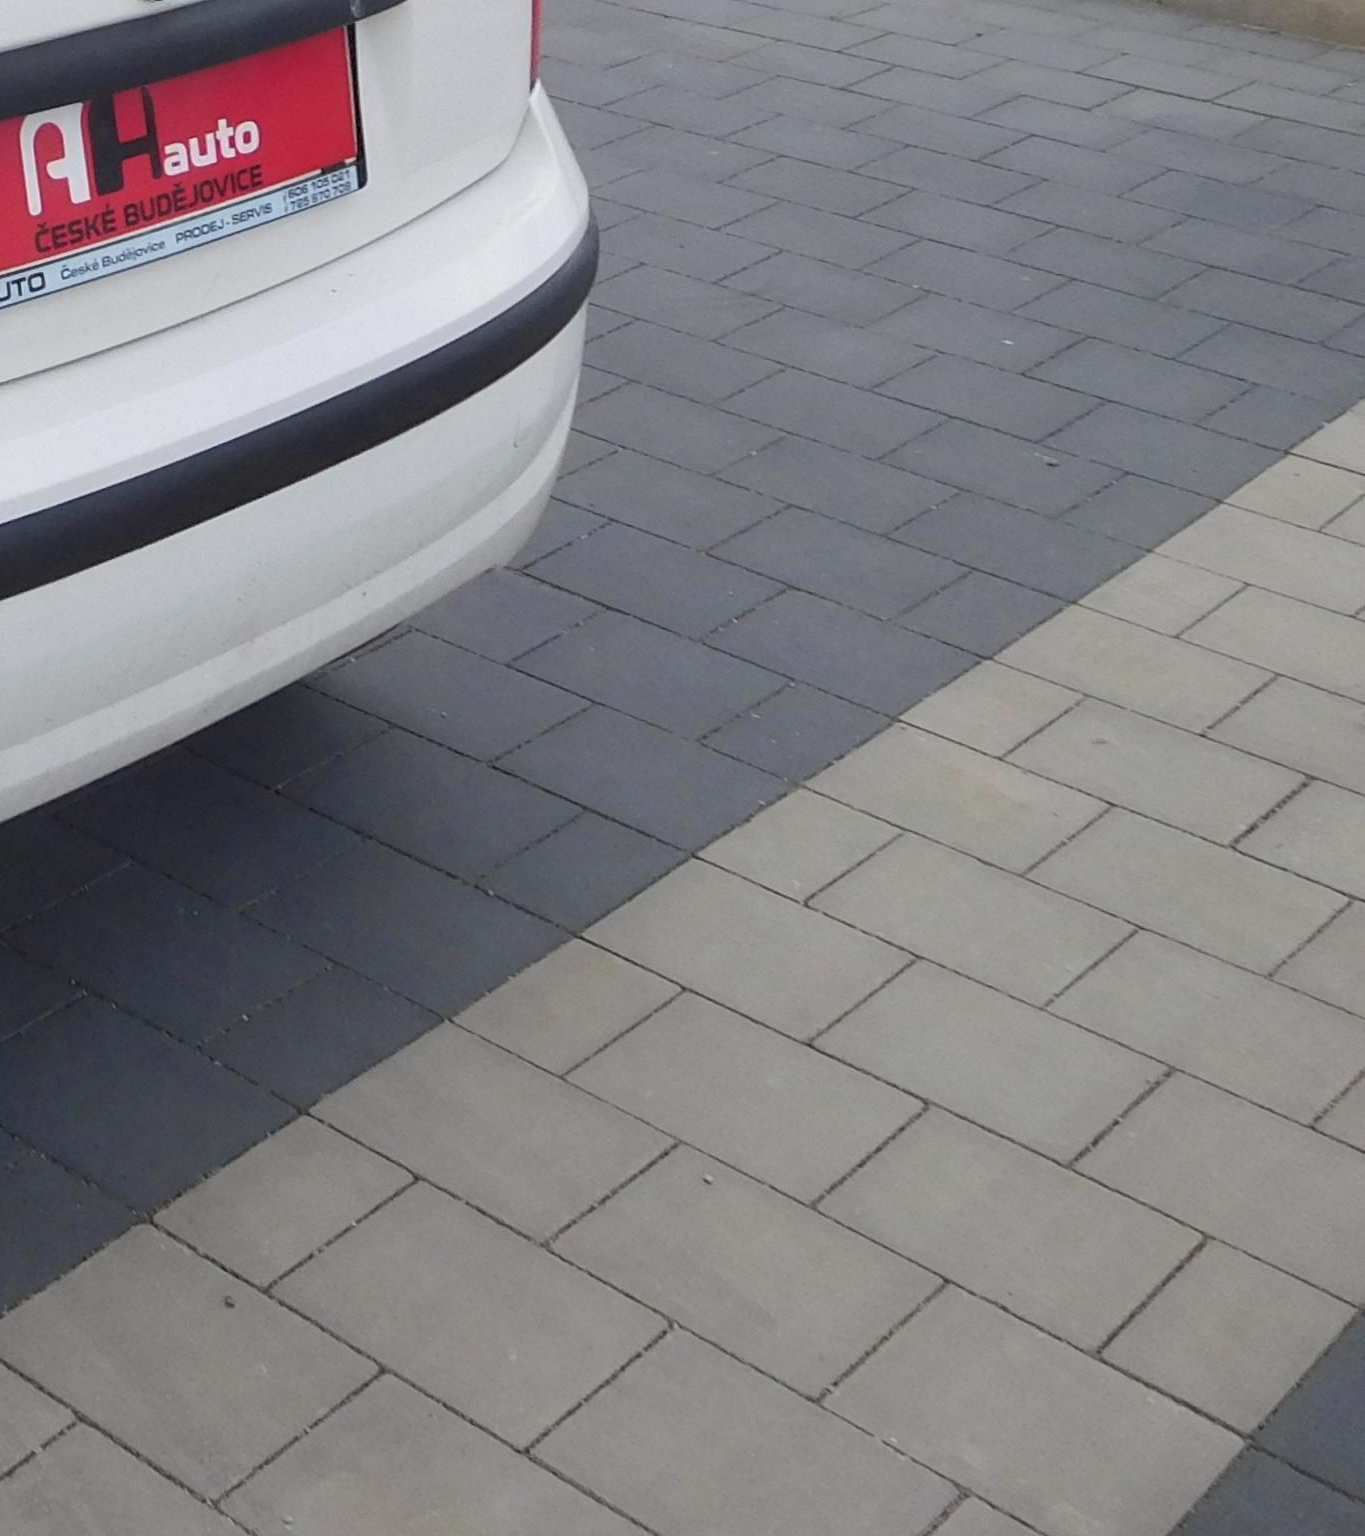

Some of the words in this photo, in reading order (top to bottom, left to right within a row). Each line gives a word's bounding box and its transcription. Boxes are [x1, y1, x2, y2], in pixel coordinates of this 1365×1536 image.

[164, 118, 261, 176] auto
[35, 204, 118, 254] ČESKÉ
[124, 164, 264, 227] BUDĚJOVICE
[60, 258, 100, 281] České
[102, 239, 166, 269] Budějovice
